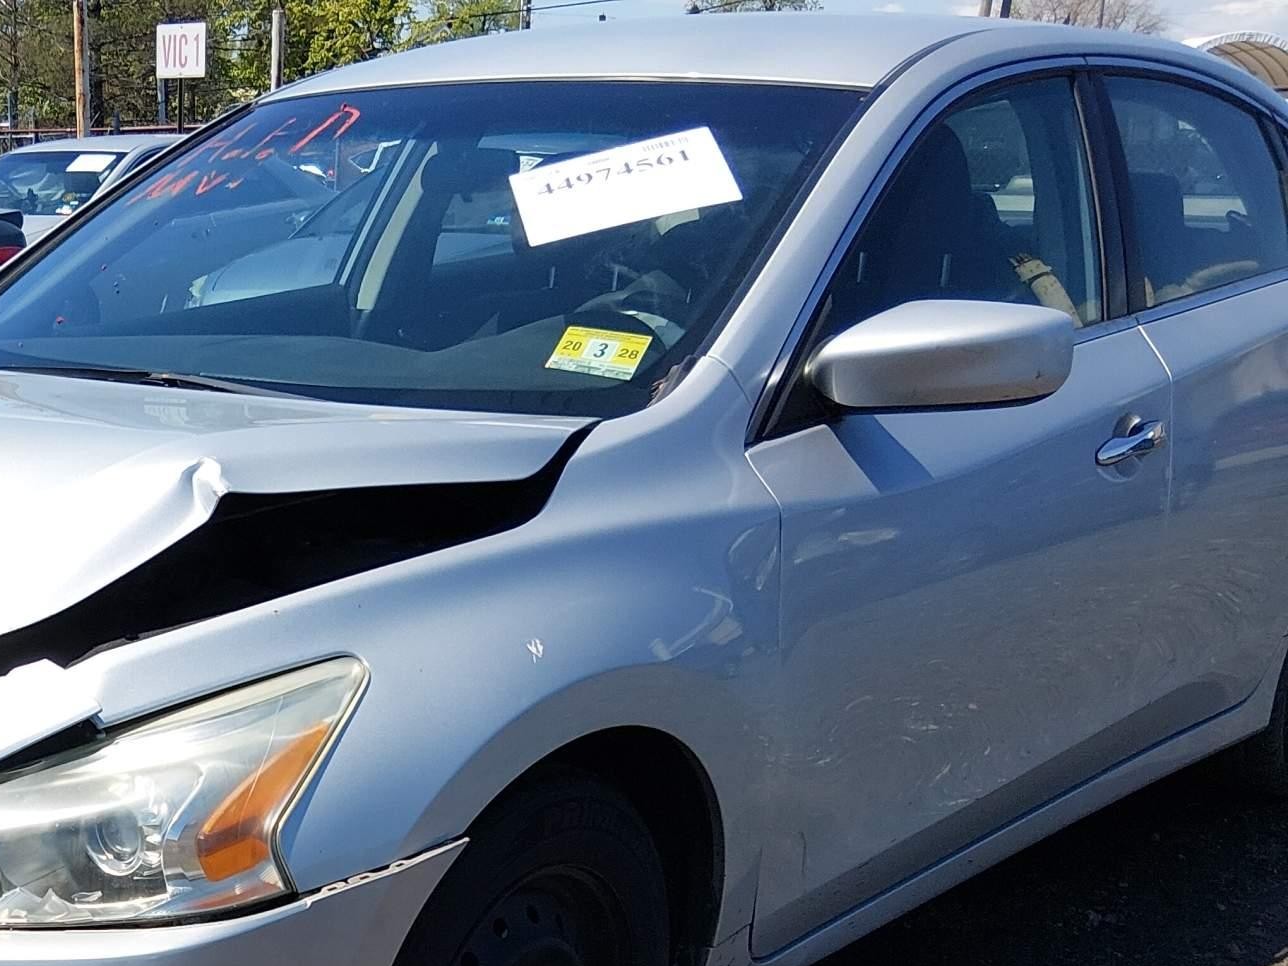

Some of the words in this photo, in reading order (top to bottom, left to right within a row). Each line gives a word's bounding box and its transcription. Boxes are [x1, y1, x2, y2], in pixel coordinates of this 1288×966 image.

[161, 33, 188, 69] VIC
[193, 33, 200, 68] 1
[537, 148, 691, 196] 44974561
[561, 340, 583, 352] 20
[592, 342, 609, 359] 3
[617, 348, 640, 360] 28
